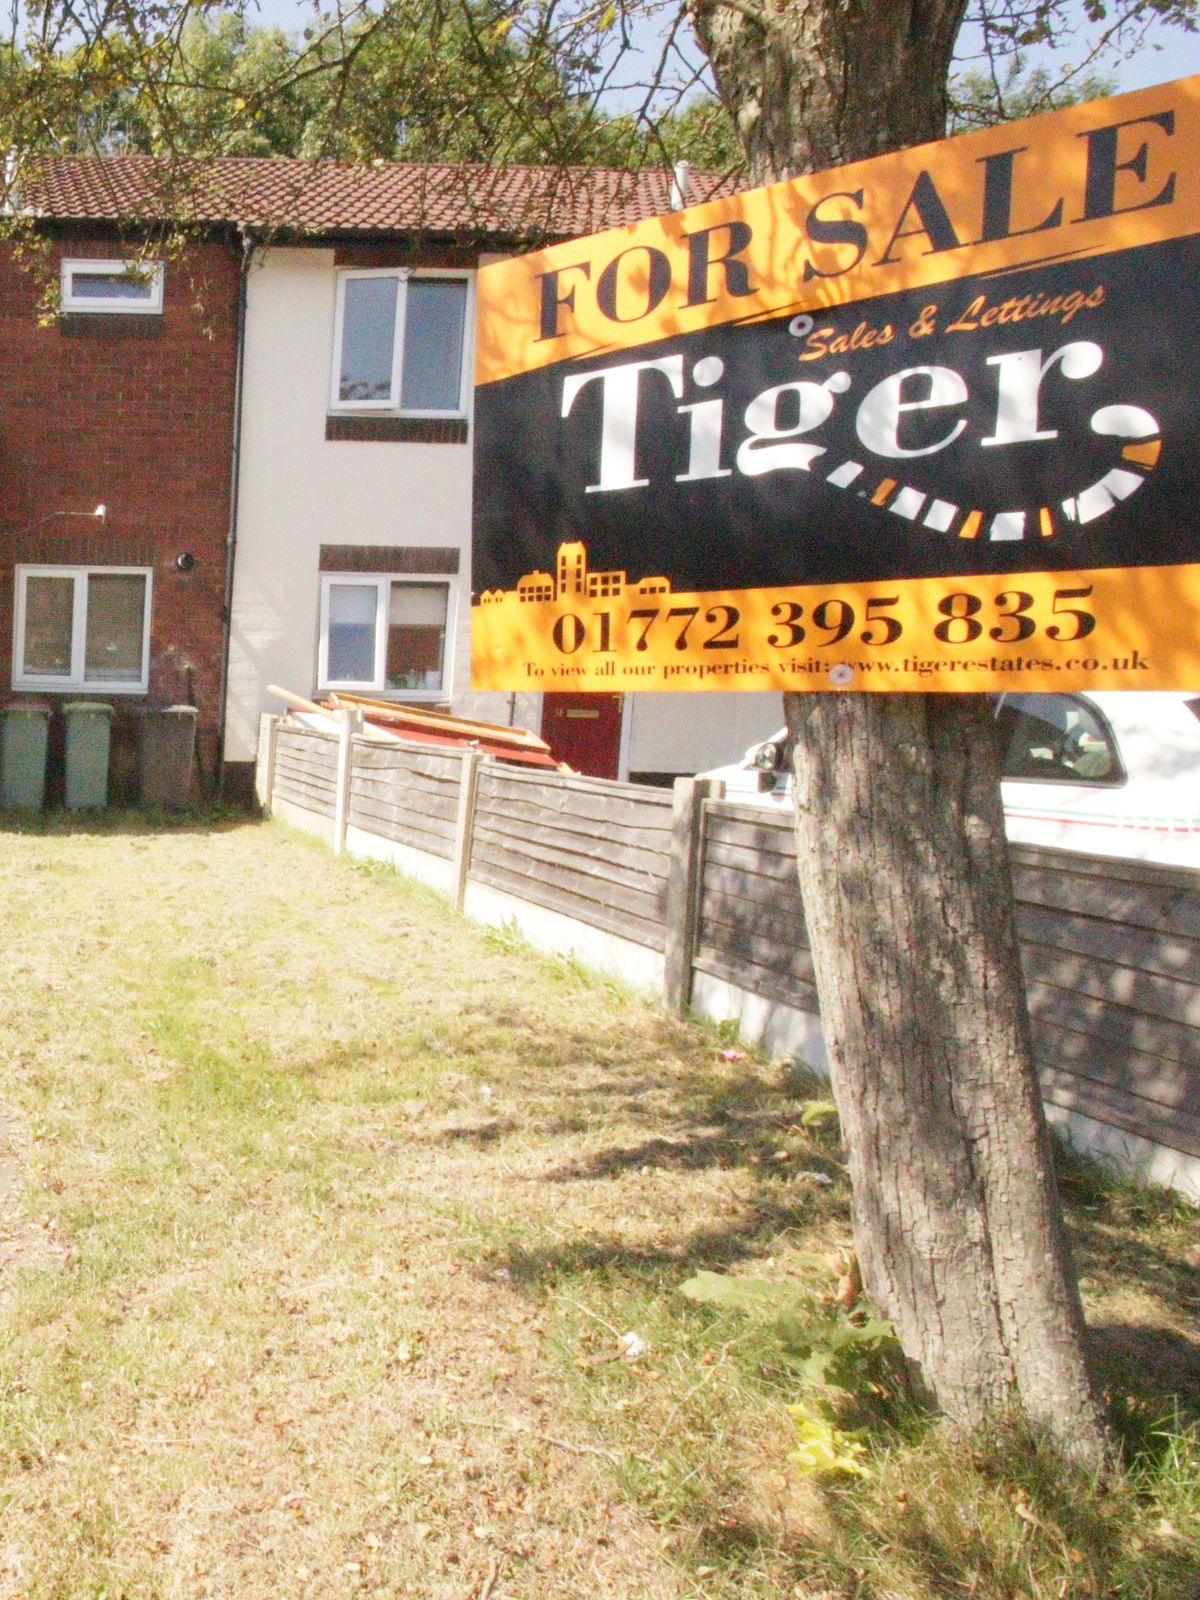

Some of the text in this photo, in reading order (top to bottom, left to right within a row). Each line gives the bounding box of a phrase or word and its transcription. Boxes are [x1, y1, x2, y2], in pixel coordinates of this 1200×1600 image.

[533, 110, 1179, 344] FOR SALE
[798, 284, 1105, 362] Sales & Lettings
[560, 340, 1104, 494] Tiger
[552, 584, 1097, 655] 01772 395 835
[522, 662, 545, 678] To
[551, 661, 591, 677] view
[595, 661, 616, 677] all
[622, 664, 653, 677] our
[663, 658, 770, 680] properties
[777, 657, 830, 675] visit:
